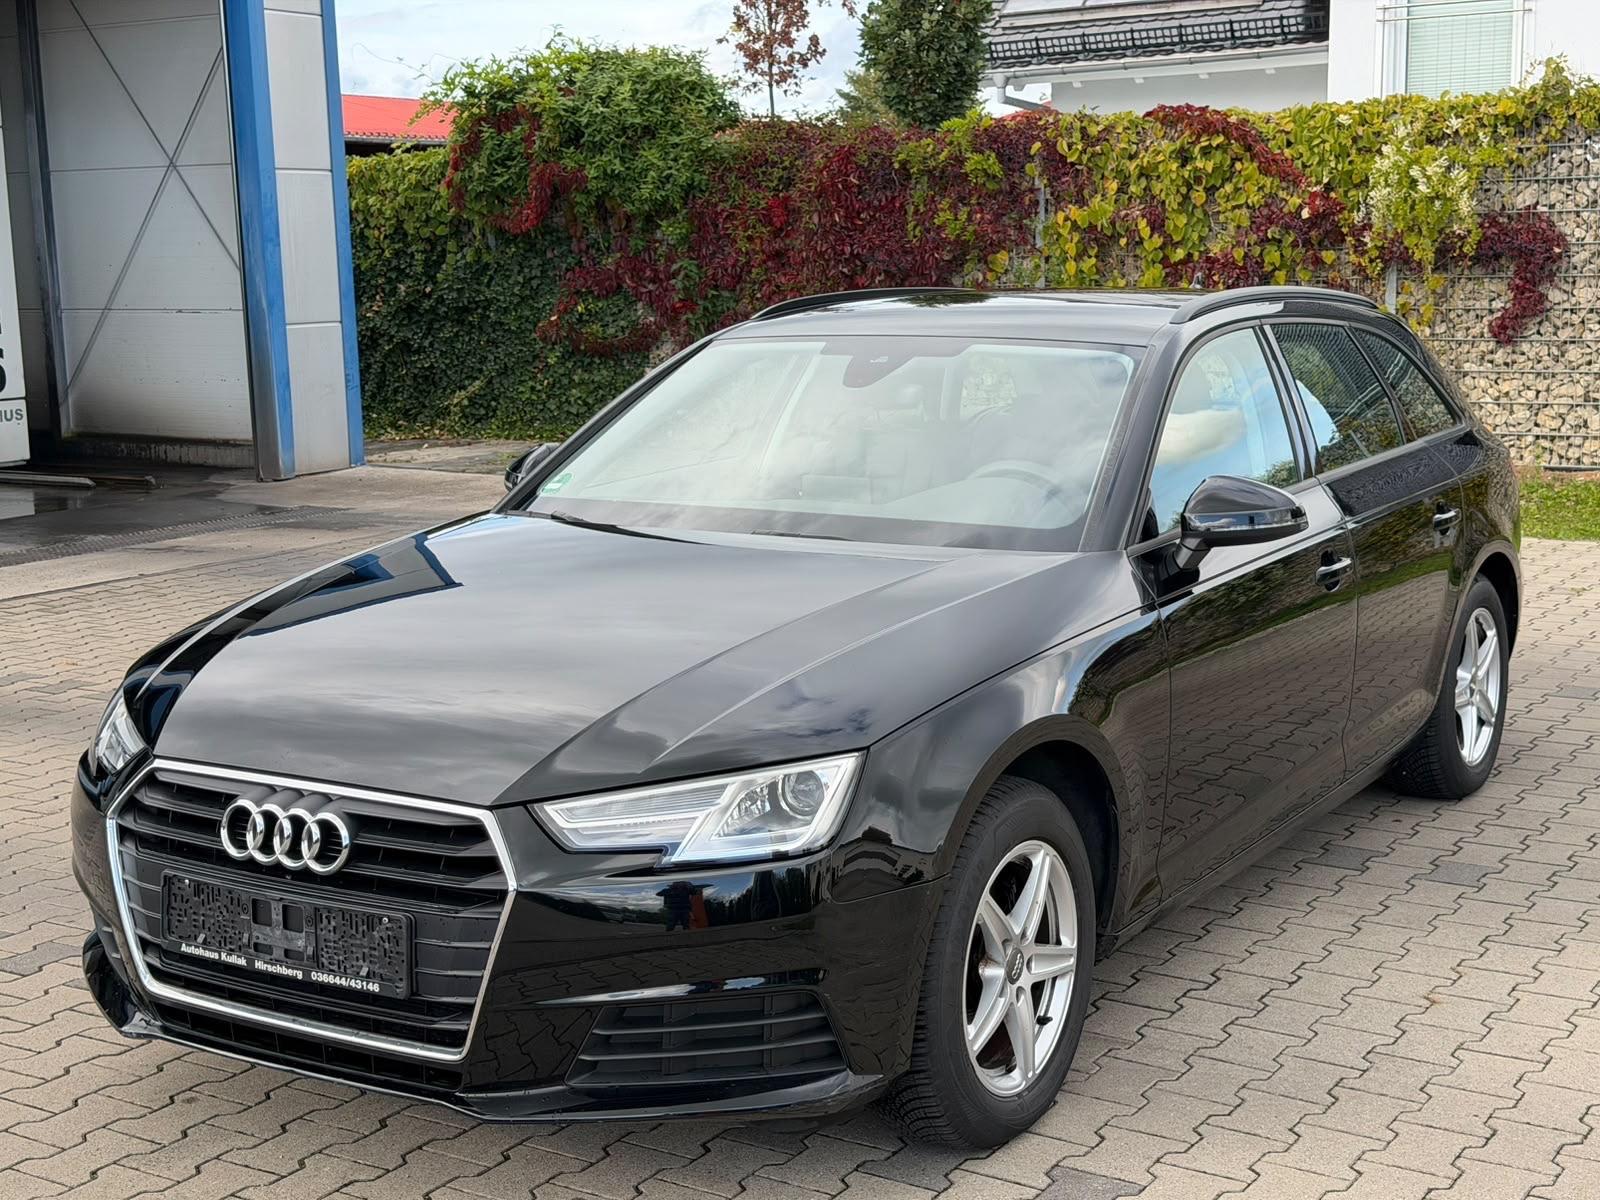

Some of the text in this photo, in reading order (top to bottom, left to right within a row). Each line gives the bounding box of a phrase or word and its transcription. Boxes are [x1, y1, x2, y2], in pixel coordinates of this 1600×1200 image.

[180, 942, 380, 993] Autohaus Kullak Hirschberg 036644/43146
